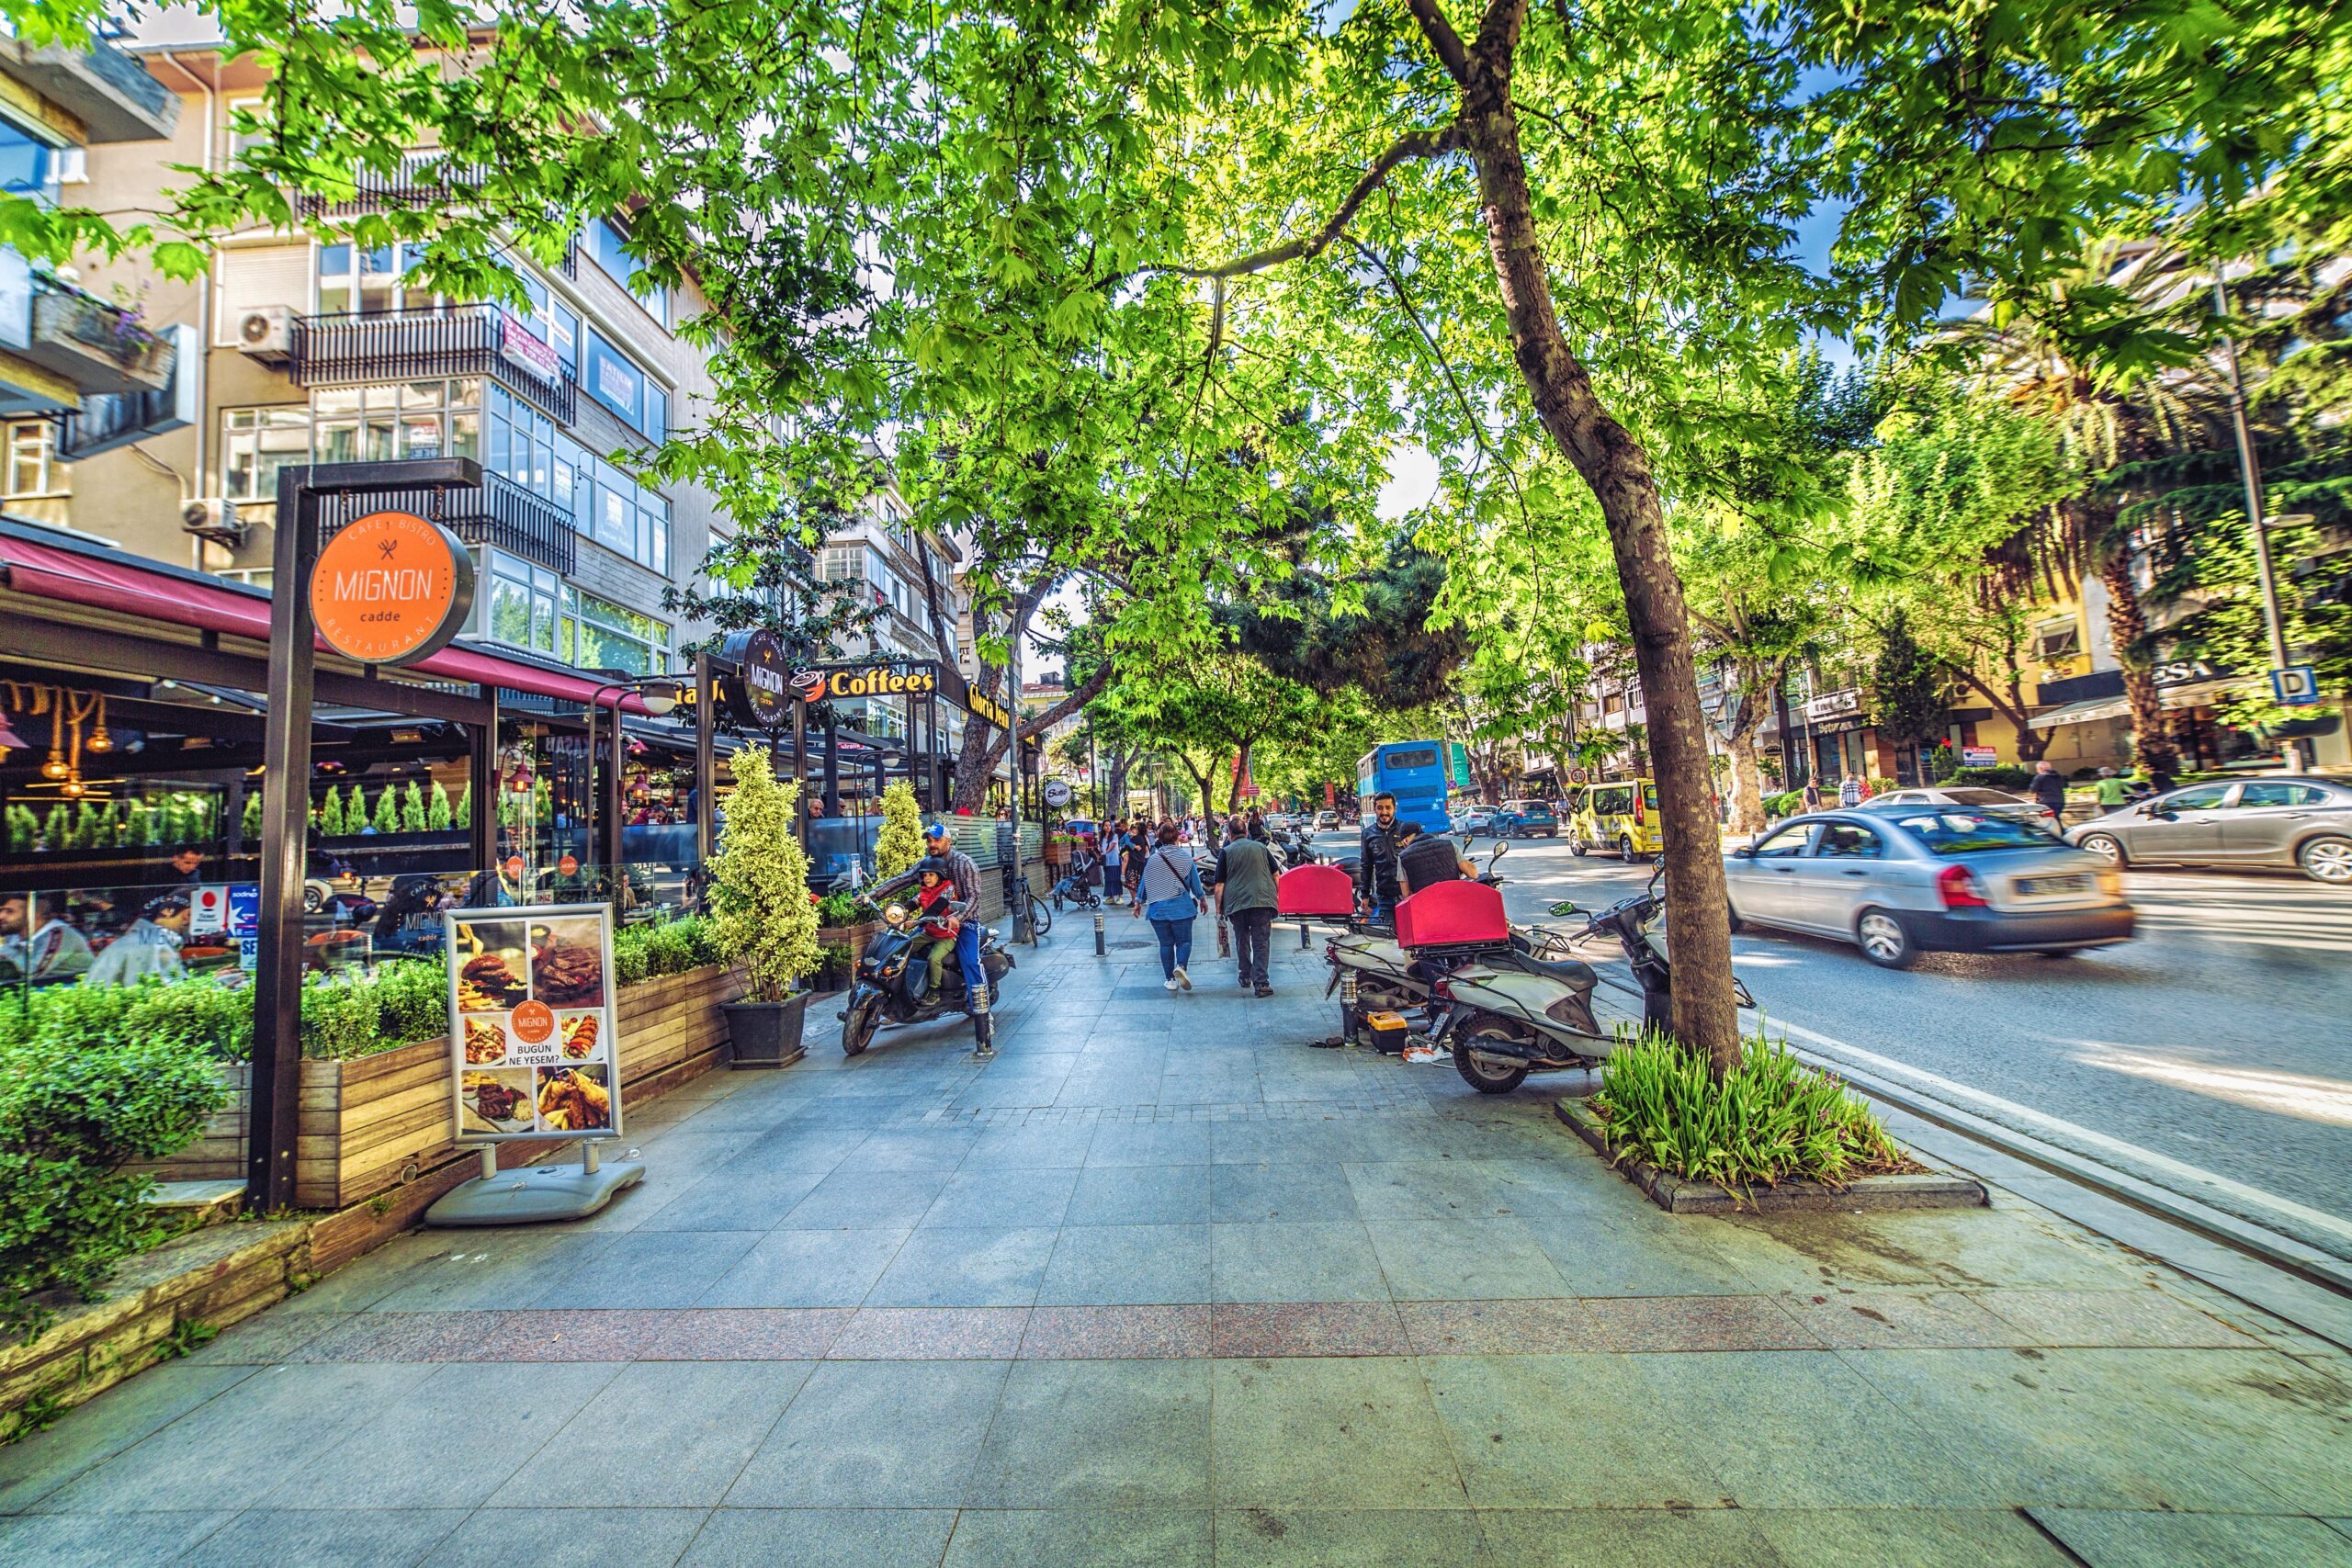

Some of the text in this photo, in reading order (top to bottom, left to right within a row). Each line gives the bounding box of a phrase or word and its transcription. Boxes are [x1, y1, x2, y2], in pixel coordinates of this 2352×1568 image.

[347, 519, 435, 546] CAFE BISTRO
[359, 611, 401, 622] cadde
[325, 616, 434, 652] RESTAURANT
[830, 669, 935, 696] Coffees
[2152, 661, 2213, 684] ESA
[2282, 672, 2303, 694] D
[969, 682, 993, 720] Gloria
[1574, 772, 1583, 780] 50
[517, 1043, 551, 1054] BUGÜN
[509, 1055, 560, 1066] NE YESEM?
